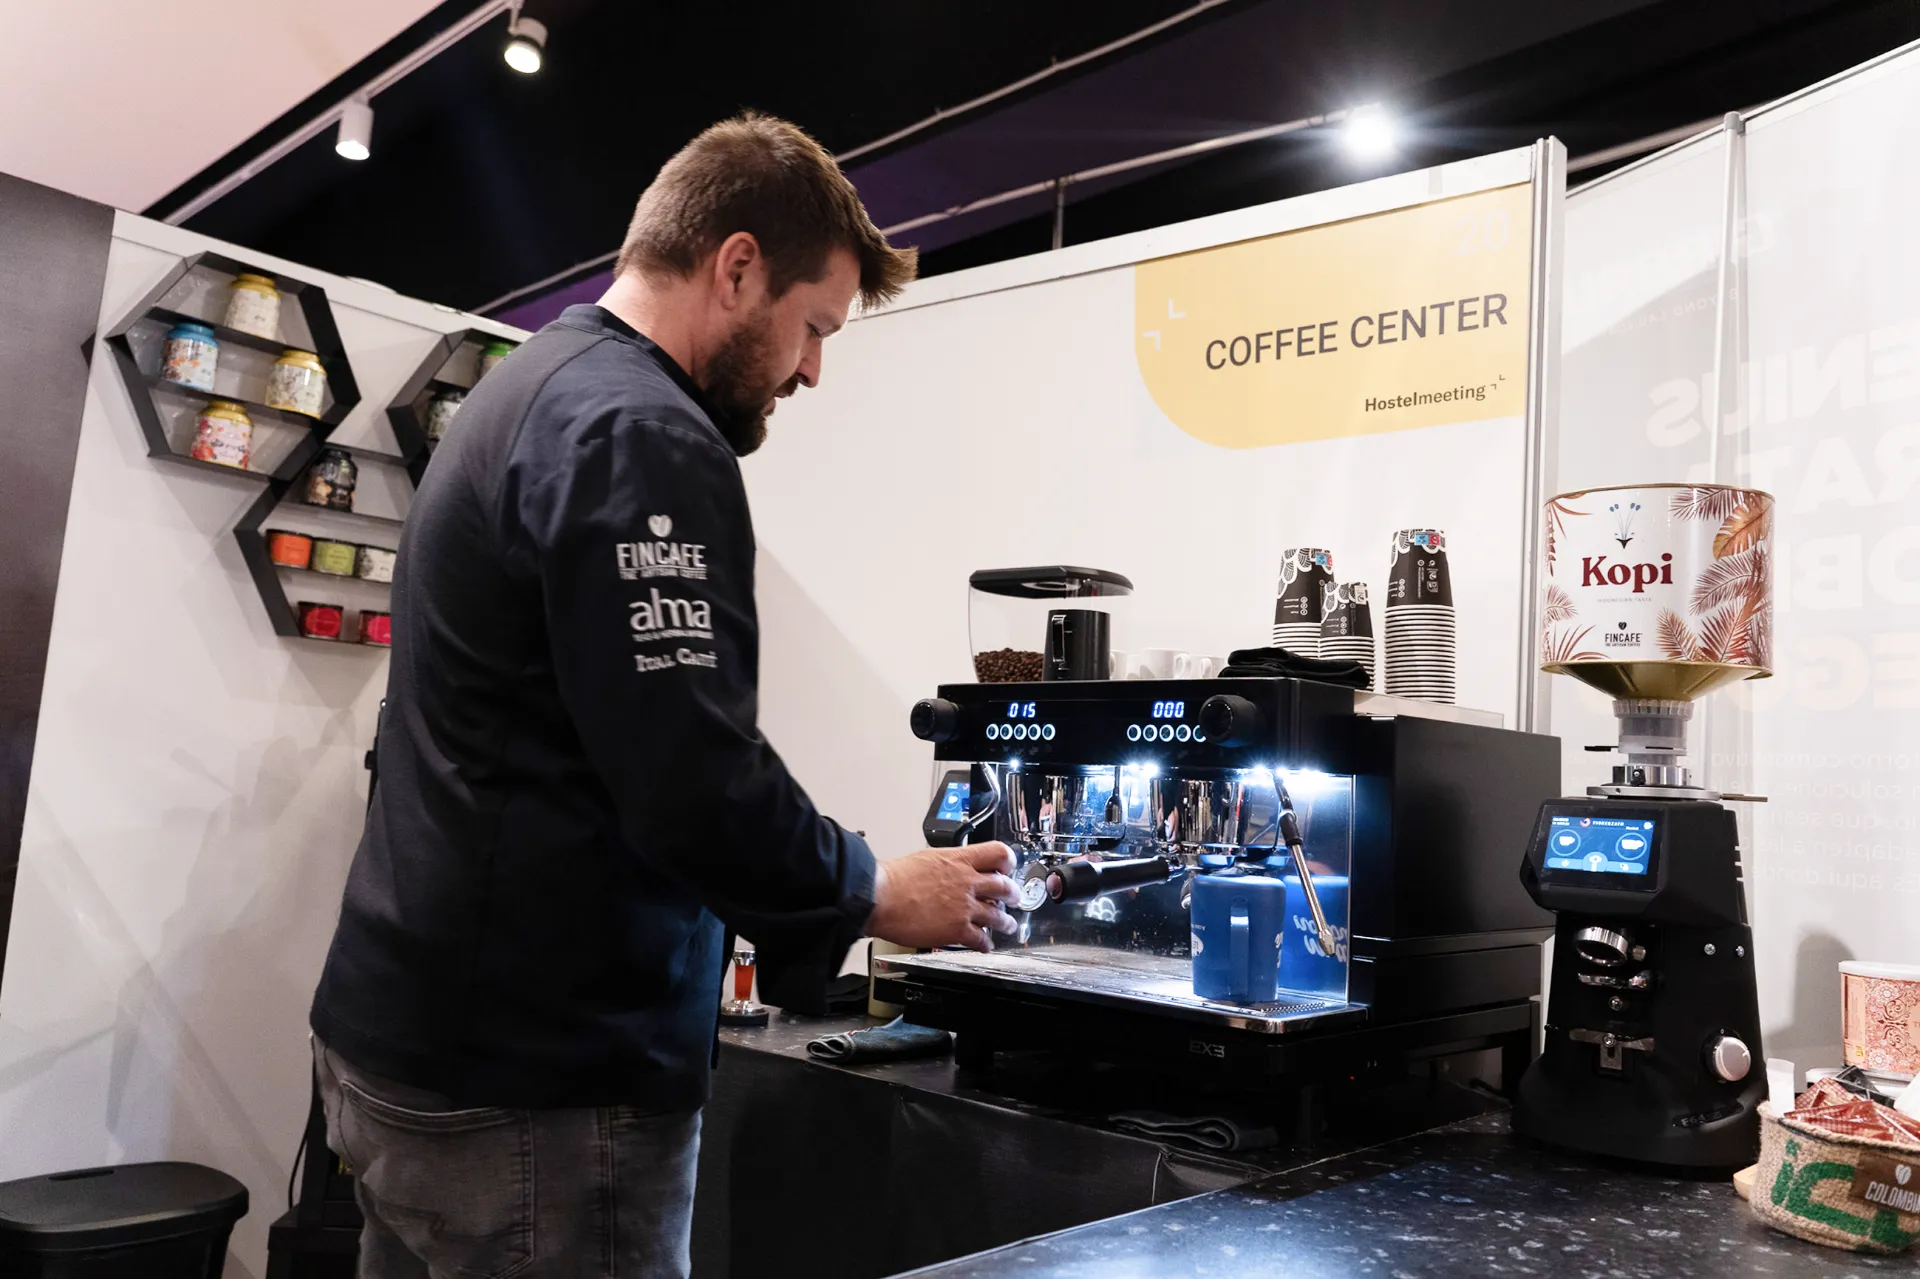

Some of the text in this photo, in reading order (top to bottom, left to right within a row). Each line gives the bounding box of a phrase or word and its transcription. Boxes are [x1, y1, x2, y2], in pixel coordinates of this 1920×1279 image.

[1453, 210, 1509, 255] 20
[1205, 293, 1509, 370] COFFEE CENTER
[1364, 384, 1486, 413] Hostelmeeting
[616, 541, 707, 568] FINCAFE
[1582, 553, 1673, 593] Kopi
[628, 587, 712, 631] alma
[1604, 632, 1641, 642] FINCAFE
[1008, 702, 1036, 718] 015
[1153, 701, 1185, 718] 000
[1189, 1041, 1225, 1058] EX3
